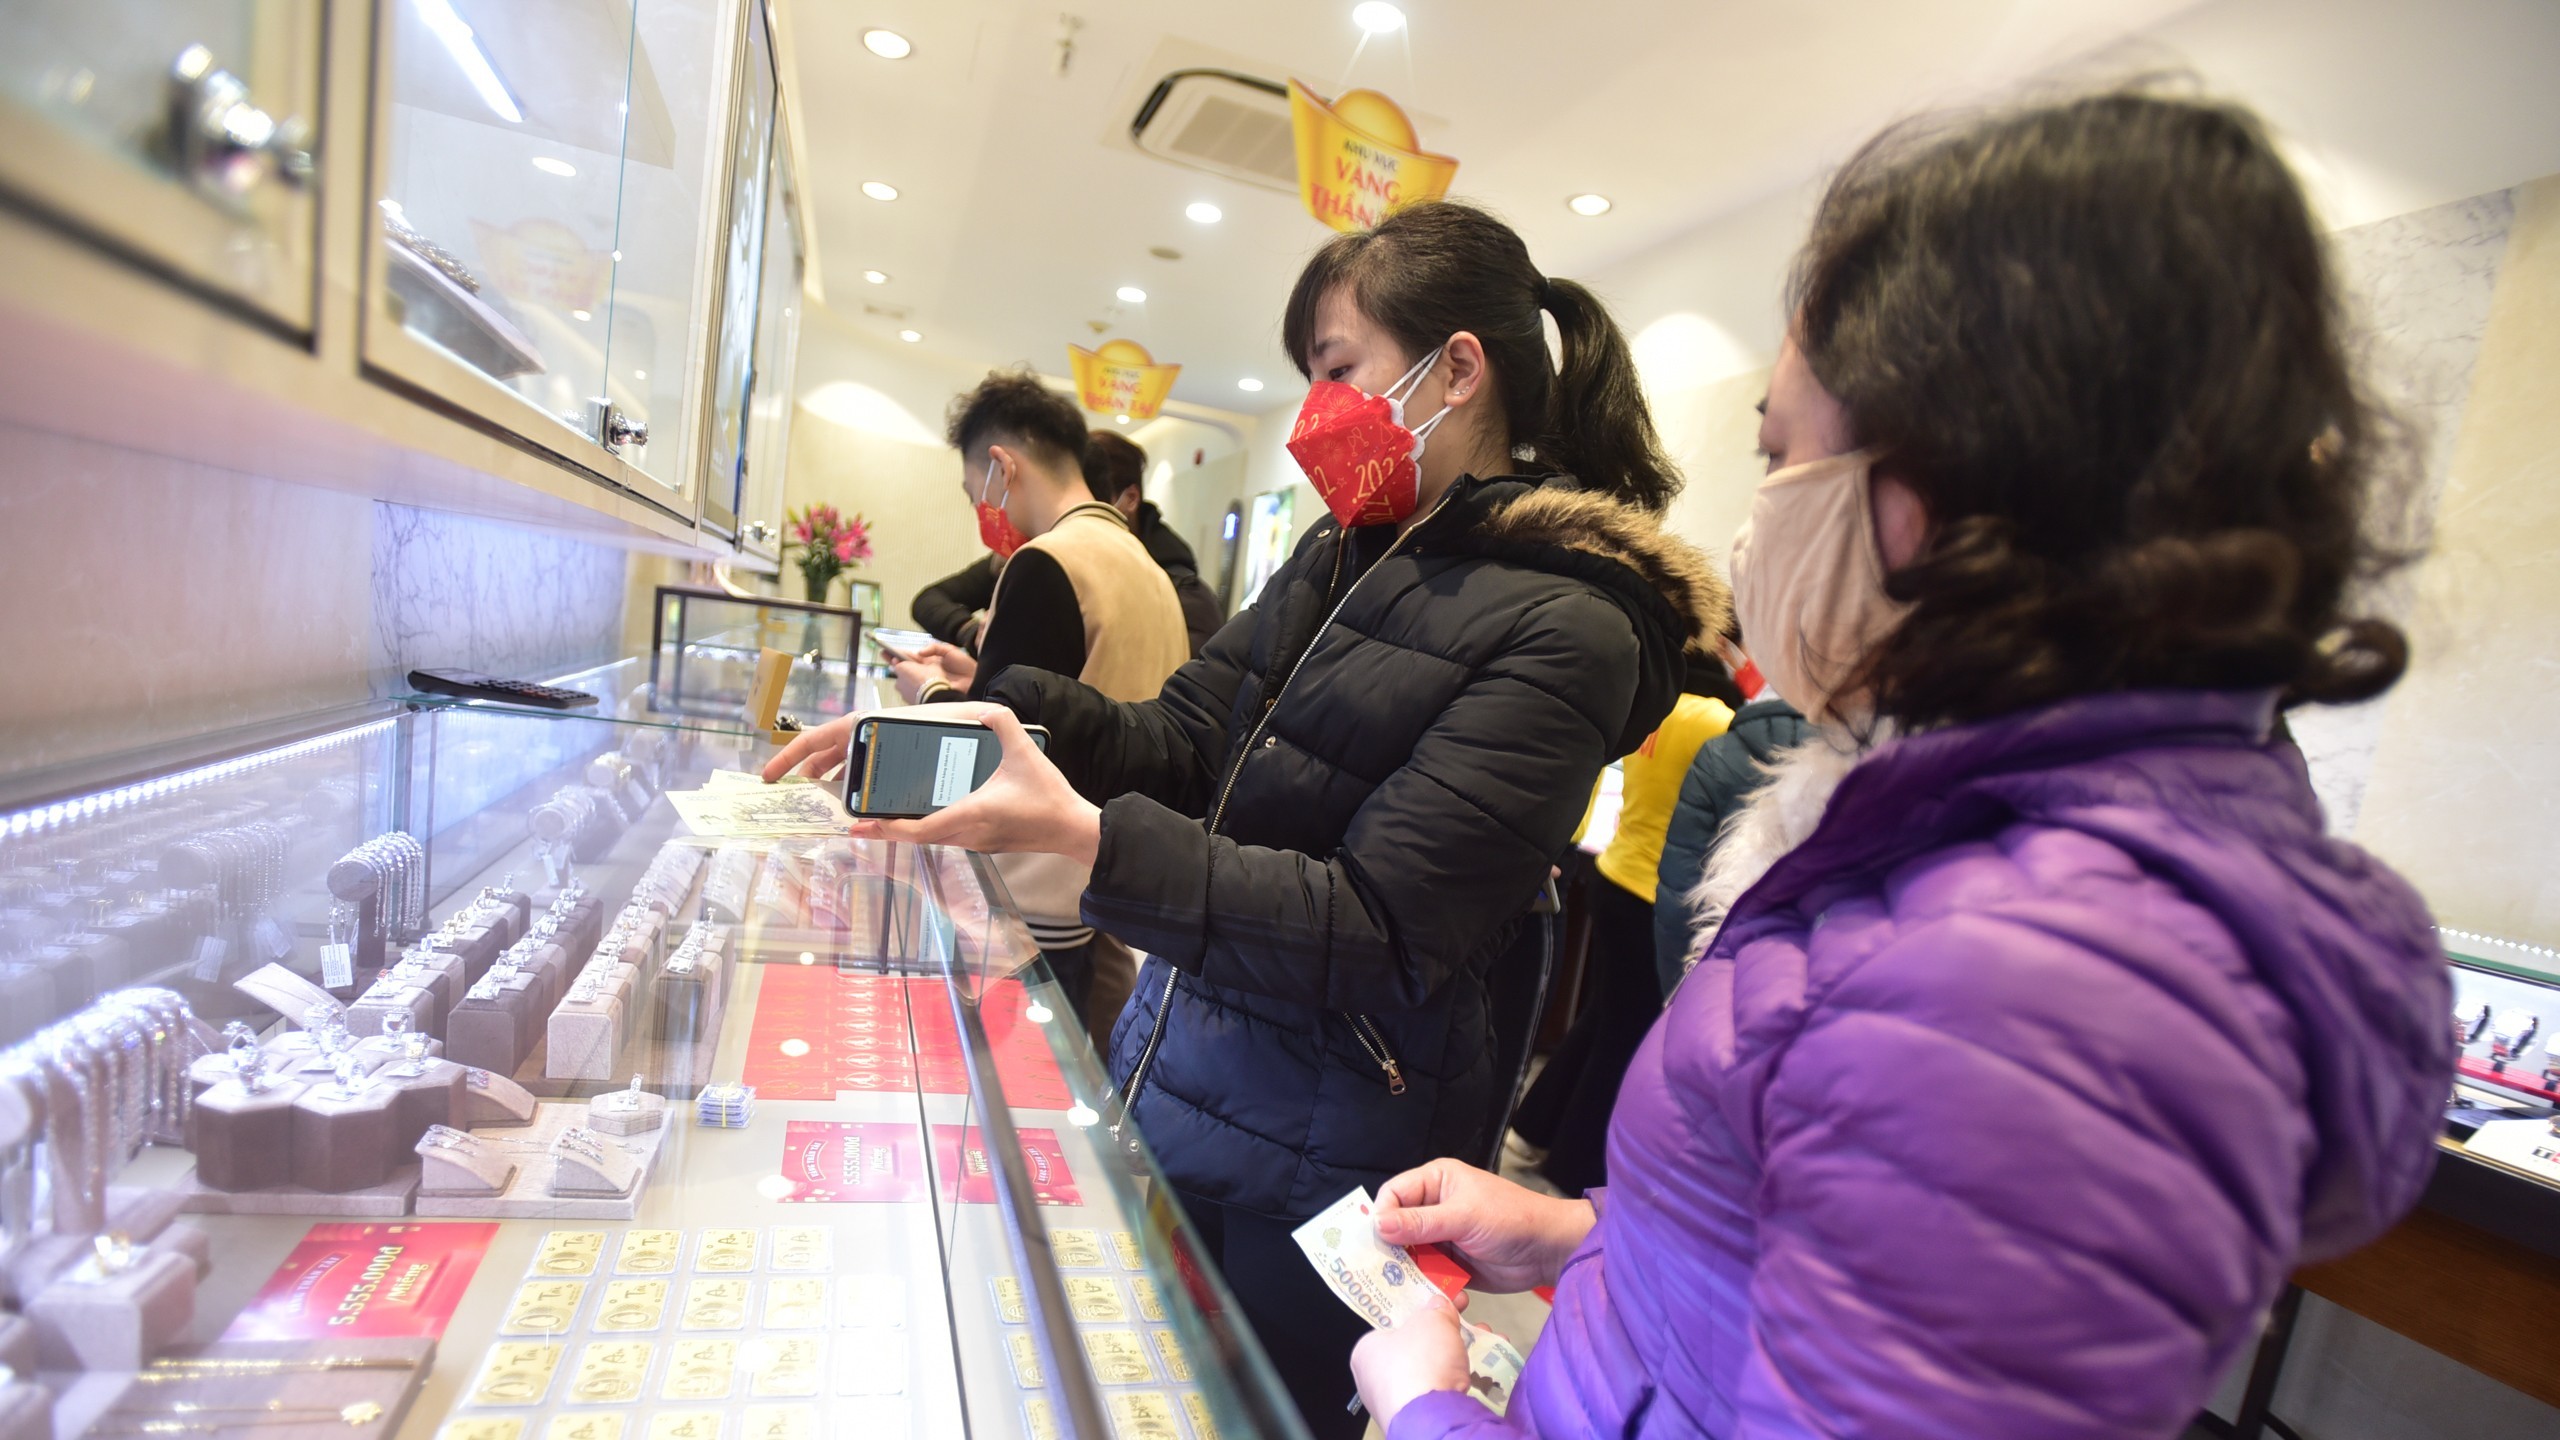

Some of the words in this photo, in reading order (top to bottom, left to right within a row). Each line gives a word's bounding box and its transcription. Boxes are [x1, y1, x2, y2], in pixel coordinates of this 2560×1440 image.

[843, 1136, 860, 1185] 5.555.000đ
[328, 1246, 405, 1326] 5.555.000đ
[385, 1263, 430, 1303] /Miếng
[1329, 1256, 1393, 1328] 500000
